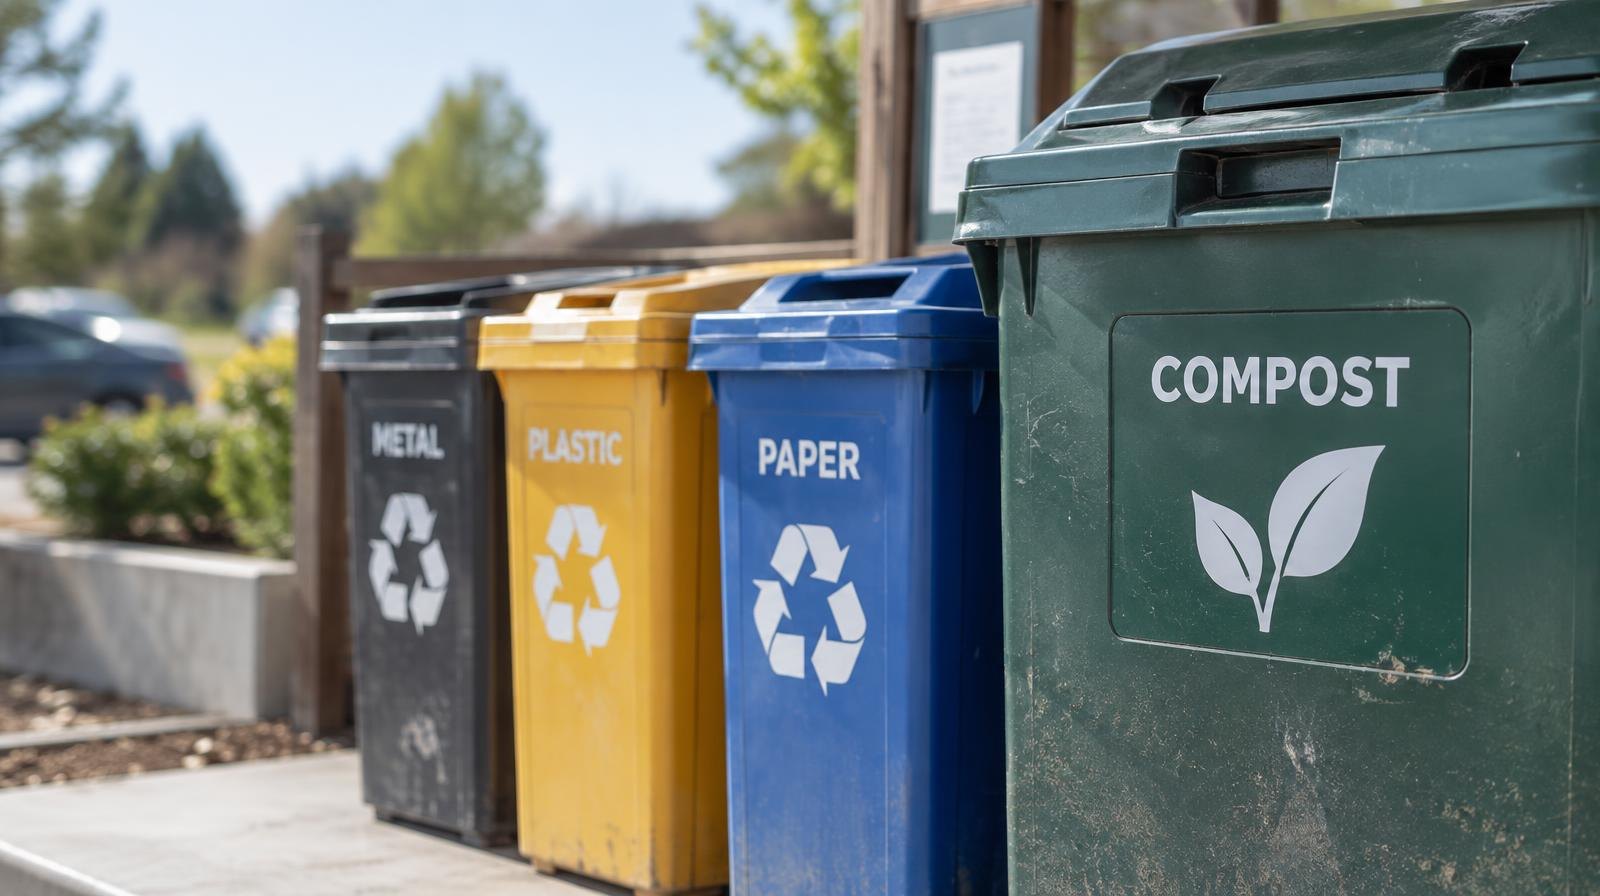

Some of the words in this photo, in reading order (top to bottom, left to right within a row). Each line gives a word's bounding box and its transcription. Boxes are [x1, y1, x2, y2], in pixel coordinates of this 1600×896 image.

[1151, 355, 1410, 407] COMPOST
[373, 423, 445, 459] METAL
[528, 428, 623, 465] PLASTIC
[758, 438, 861, 480] PAPER
